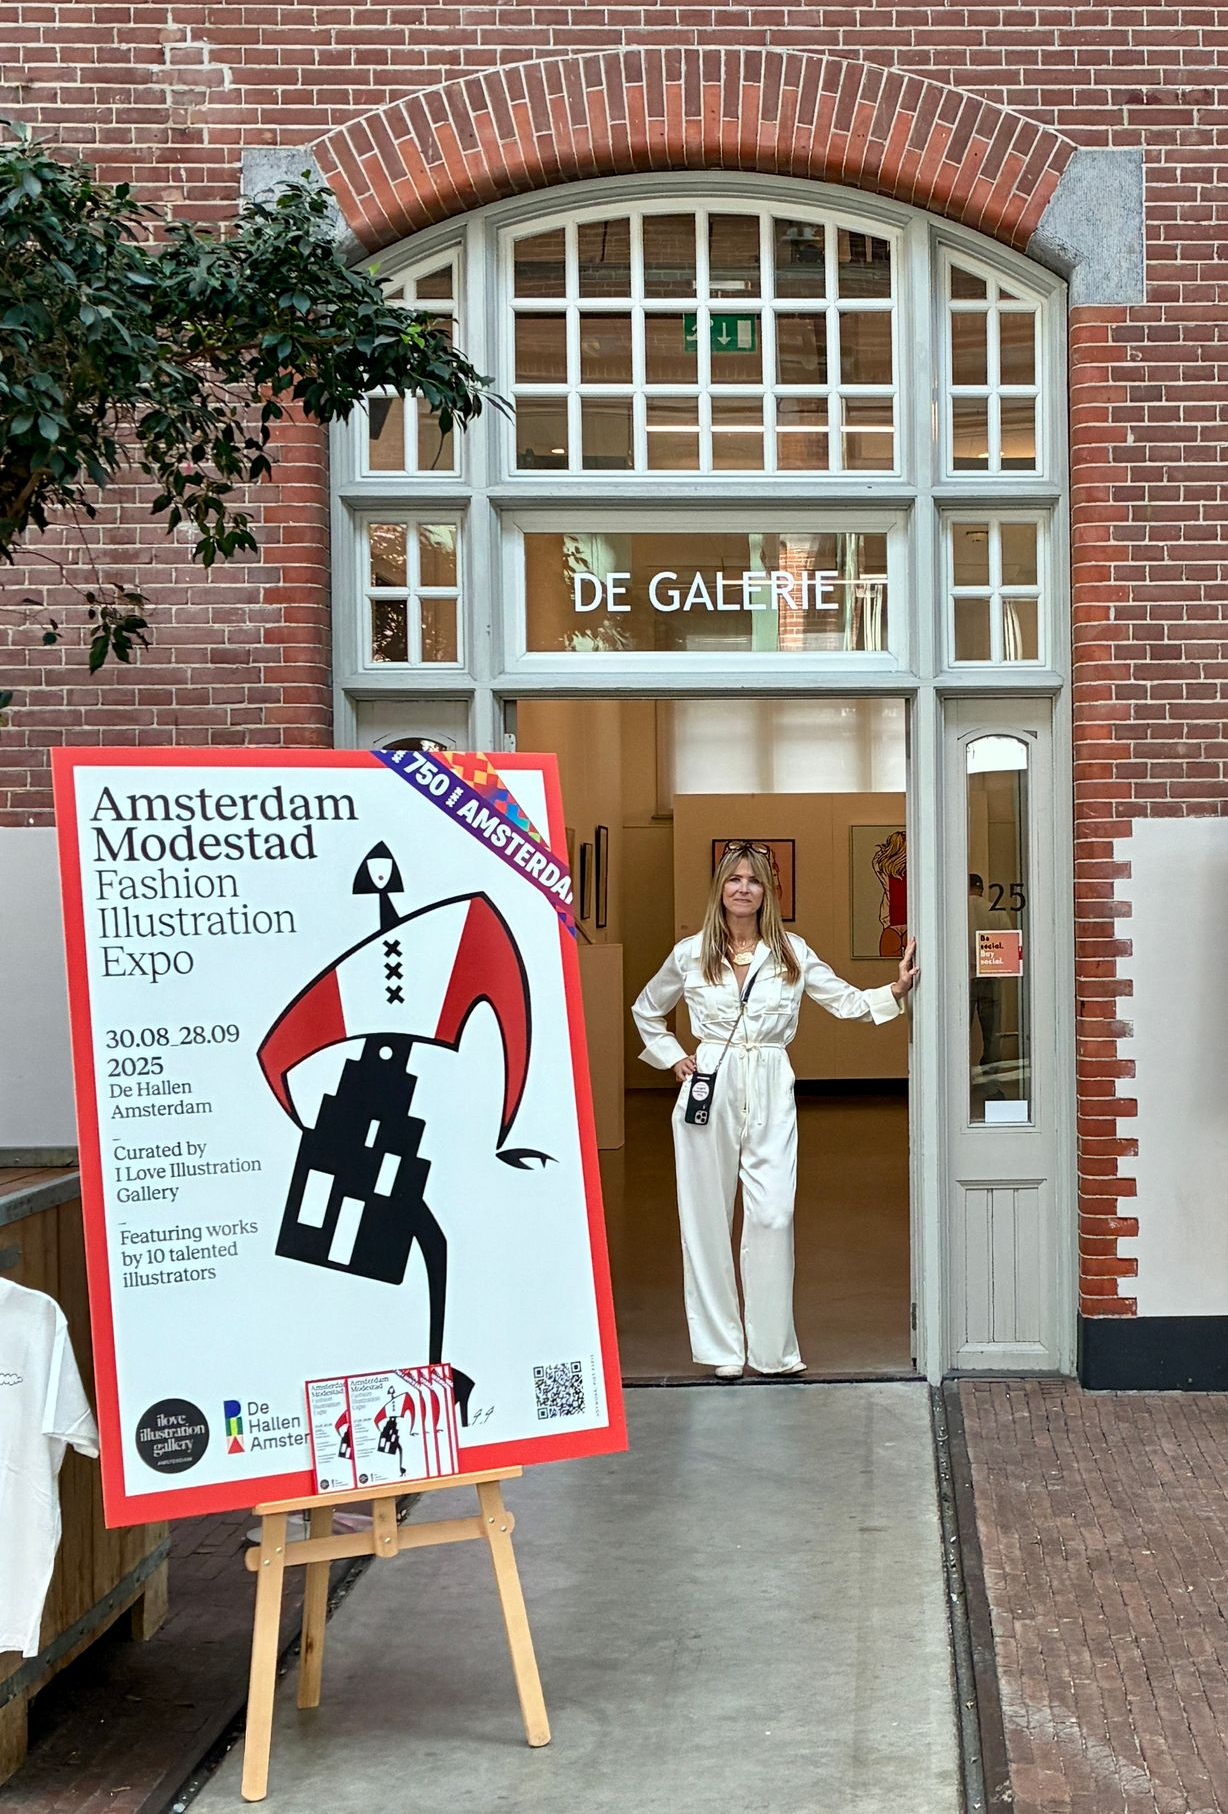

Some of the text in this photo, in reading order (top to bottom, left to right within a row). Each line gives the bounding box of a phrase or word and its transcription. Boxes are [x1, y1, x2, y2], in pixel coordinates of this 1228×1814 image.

[574, 571, 839, 612] DE GALERIE
[90, 786, 358, 821] Amsterdam
[404, 751, 574, 905] 750 AMSTERDA
[92, 824, 318, 861] Modestad
[96, 868, 239, 900] Fashion
[988, 883, 1026, 911] 25
[98, 904, 296, 938] Illustration
[101, 946, 194, 983] Expo
[106, 1025, 240, 1048] 30.08_28.09
[107, 1057, 164, 1077] 2025
[109, 1080, 193, 1099] De Hallen
[111, 1100, 213, 1120] Amsterdam
[114, 1141, 207, 1161] Curated by
[115, 1158, 262, 1182] I Love Illustration
[116, 1186, 179, 1203] Gallery
[120, 1220, 258, 1245] Featuring works
[121, 1241, 238, 1269] by 10 talented
[123, 1267, 216, 1288] illustrators
[248, 1402, 269, 1416] De
[140, 1423, 205, 1442] illustration
[249, 1417, 300, 1434] Hallen
[153, 1438, 194, 1458] gallery
